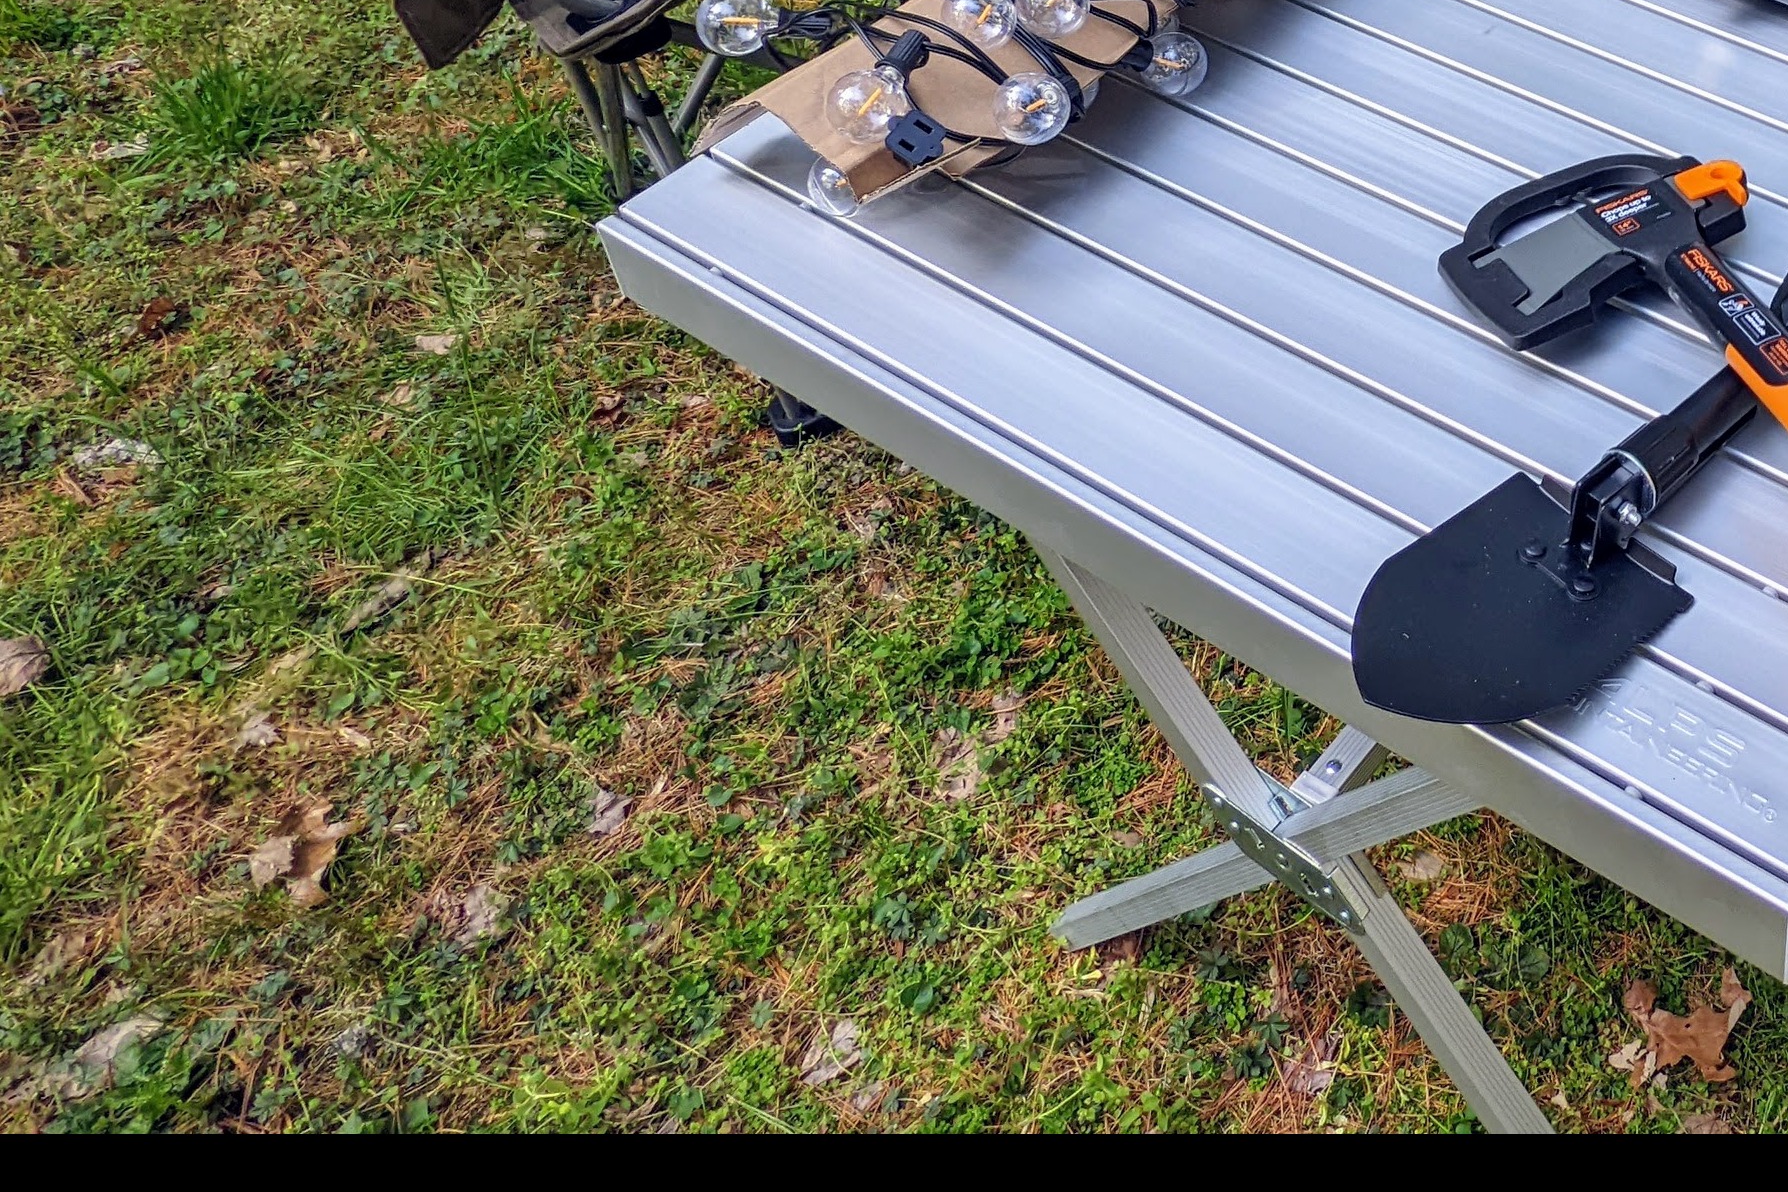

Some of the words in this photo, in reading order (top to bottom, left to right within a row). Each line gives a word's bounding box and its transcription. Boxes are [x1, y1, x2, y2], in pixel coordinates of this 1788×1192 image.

[1601, 204, 1629, 218] Chops
[1629, 199, 1641, 207] up
[1618, 202, 1647, 217] deeper
[1688, 249, 1732, 292] FISKARS
